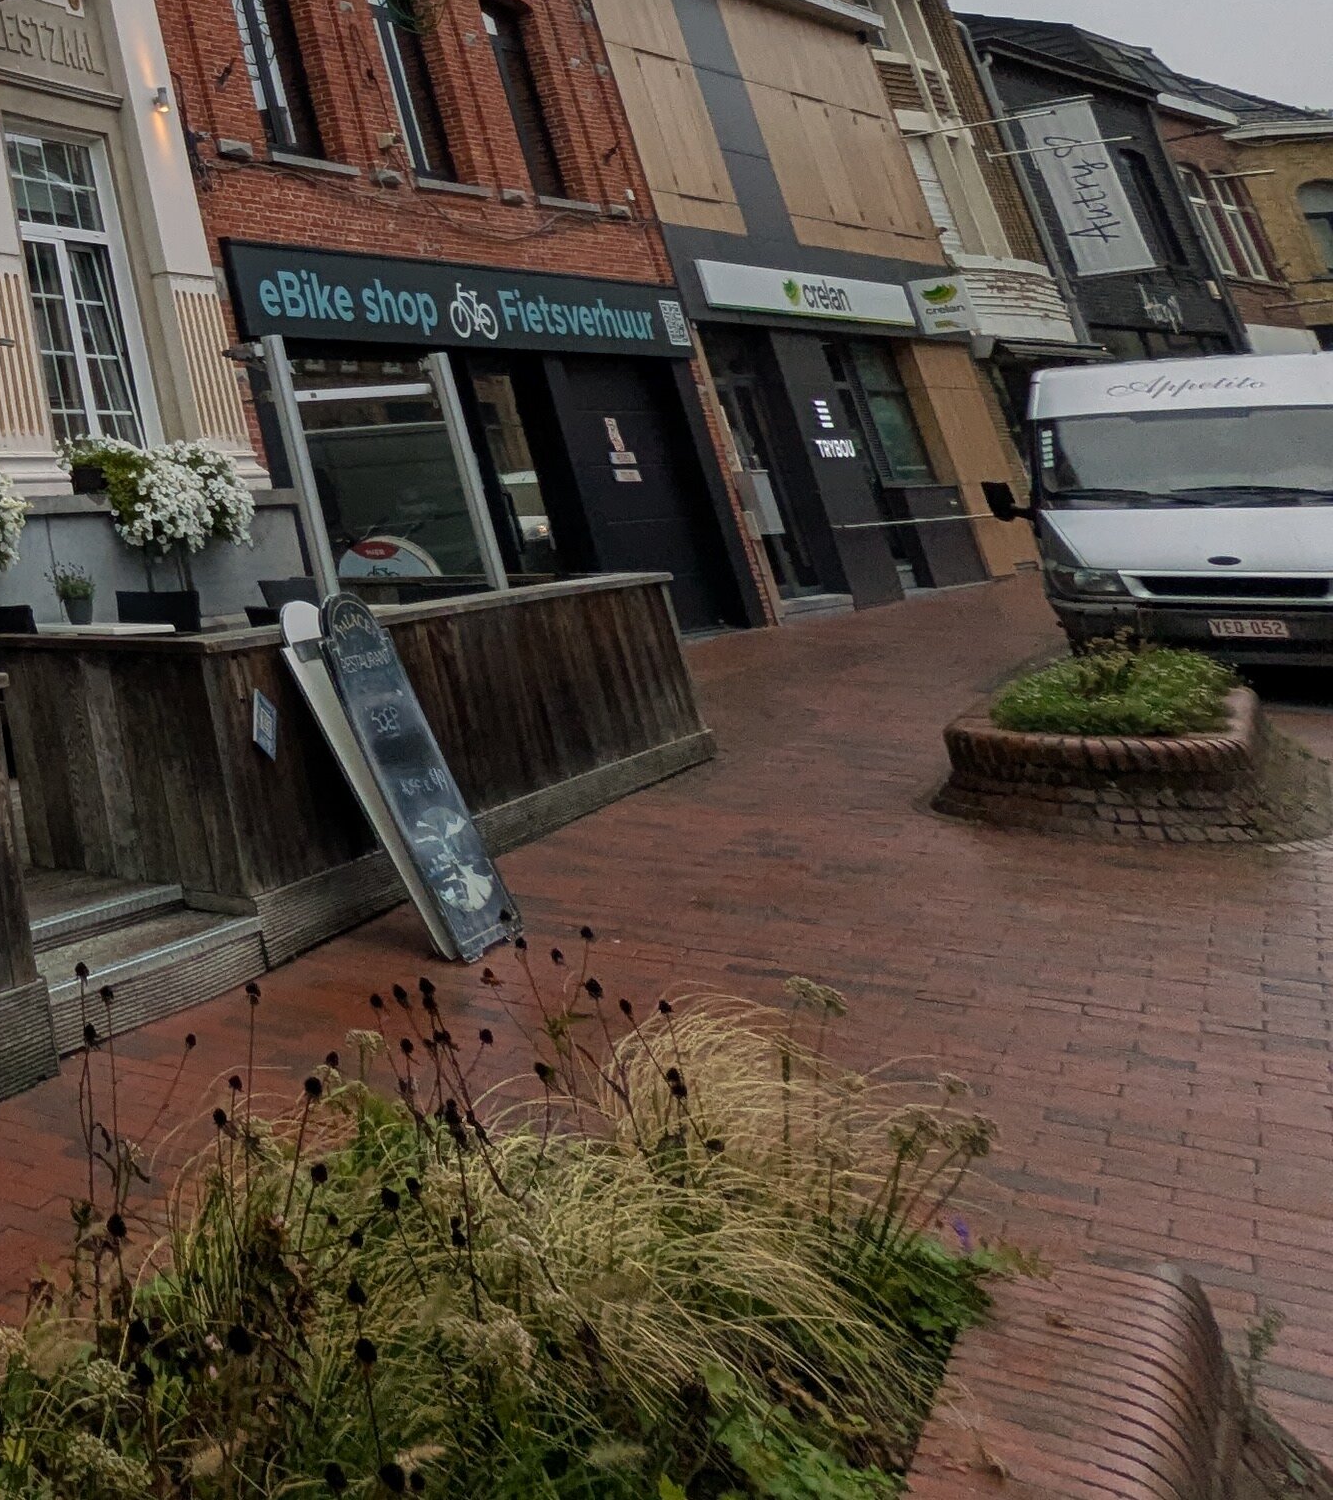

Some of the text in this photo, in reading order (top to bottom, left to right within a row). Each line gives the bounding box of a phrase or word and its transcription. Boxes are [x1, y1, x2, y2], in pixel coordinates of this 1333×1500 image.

[1068, 159, 1121, 243] Autry
[259, 269, 655, 341] eBike shop Fietsverhuur
[802, 279, 852, 312] crelan
[1106, 375, 1264, 399] Appetito
[815, 439, 856, 458] TRYBOU
